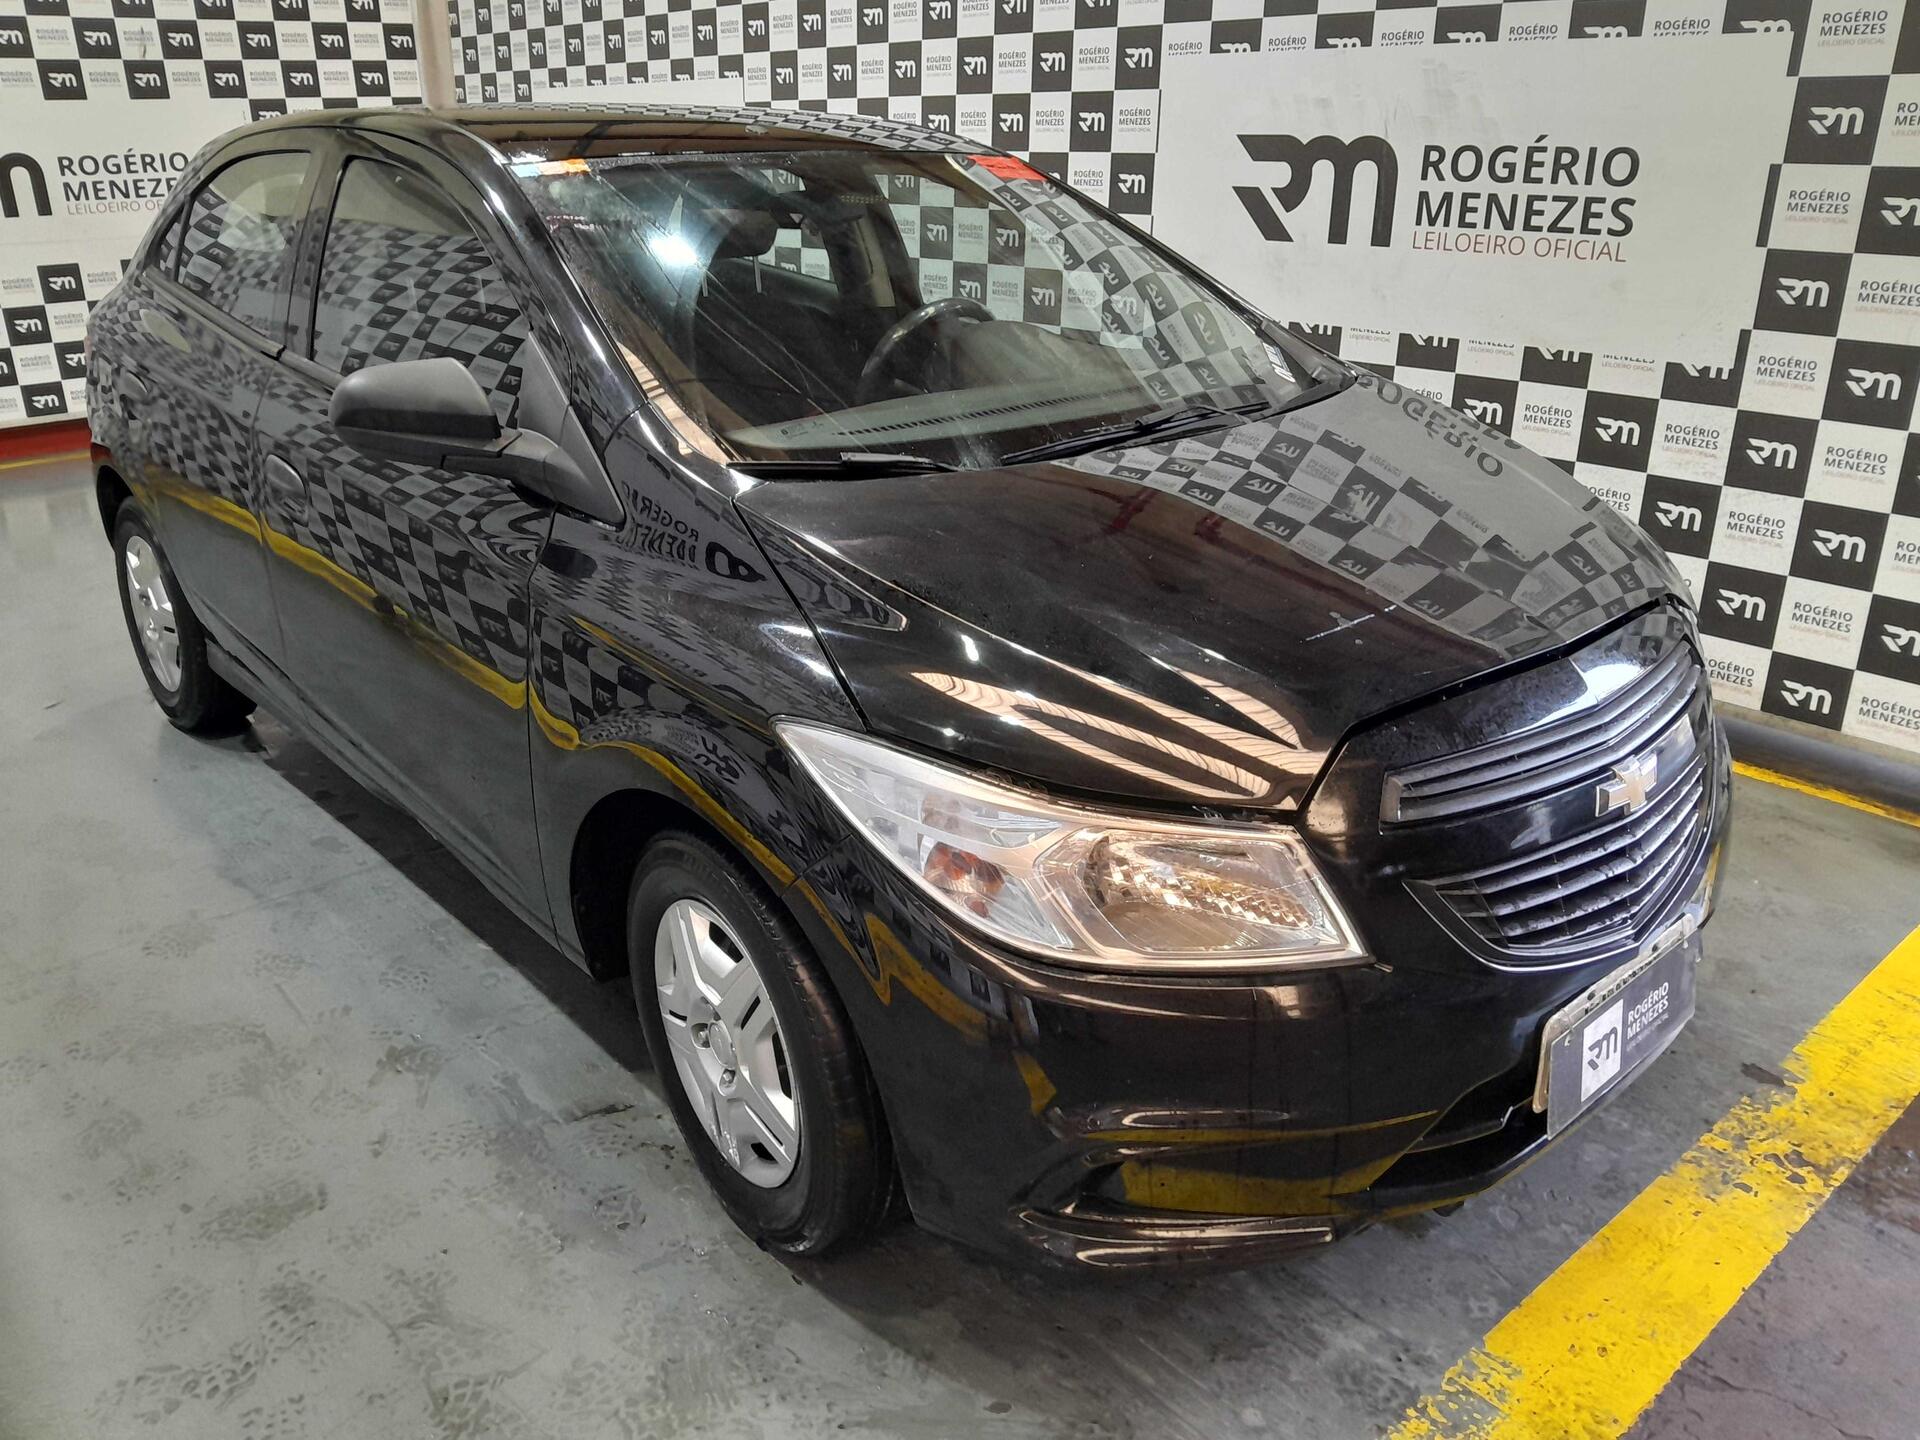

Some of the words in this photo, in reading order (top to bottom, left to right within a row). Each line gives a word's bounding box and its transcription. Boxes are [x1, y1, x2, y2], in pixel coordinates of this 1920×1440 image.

[829, 8, 851, 18] ROGÉRIO
[892, 2, 916, 12] ROGÉRIO
[772, 14, 792, 23] ROGÉRIO
[830, 16, 852, 25] MENEZES
[892, 10, 917, 19] MENEZES
[1822, 10, 1887, 24] ROGÉRIO
[772, 22, 792, 30] MENEZES
[1509, 24, 1558, 36] ROGÉRIO
[1654, 17, 1711, 31] ROGÉRIO
[1820, 24, 1886, 36] MENEZES
[1268, 36, 1307, 47] ROGÉRIO
[1381, 30, 1425, 41] ROGÉRIO
[1078, 45, 1109, 55] ROGÉRIO
[1168, 41, 1203, 51] ROGÉRIO
[926, 55, 951, 64] ROGÉRIO
[998, 50, 1026, 60] ROGÉRIO
[1078, 54, 1109, 64] MENEZES
[801, 62, 822, 70] ROGÉRIO
[861, 59, 883, 67] ROGÉRIO
[926, 63, 951, 71] MENEZES
[998, 59, 1026, 68] MENEZES
[861, 66, 883, 74] MENEZES
[960, 110, 986, 119] ROGÉRIO
[1035, 109, 1064, 118] ROGÉRIO
[1118, 107, 1150, 116] ROGÉRIO
[1035, 118, 1064, 126] MENEZES
[1118, 117, 1150, 125] MENEZES
[57, 148, 189, 177] ROGÉRIO
[1421, 134, 1640, 187] ROGÉRIO
[1073, 167, 1103, 176] ROGÉRIO
[1073, 176, 1103, 184] MENEZES
[1789, 189, 1851, 202] ROGÉRIO
[67, 200, 141, 216] LEILOEIRO
[1787, 201, 1850, 214] MENEZES
[1415, 191, 1637, 237] MENEZES
[1412, 231, 1525, 255] LEILOEIRO
[1534, 237, 1627, 262] OFICIAL
[1757, 356, 1817, 371] ROGÉRIO
[1756, 366, 1816, 382] MENEZES
[1526, 404, 1573, 418] ROGÉRIO
[1524, 413, 1573, 428] MENEZES
[1666, 424, 1720, 440] ROGÉRIO
[1664, 433, 1719, 450] MENEZES
[1825, 446, 1888, 464] ROGÉRIO
[1823, 457, 1886, 475] MENEZES
[1589, 487, 1631, 501] OGÉRIO
[1728, 511, 1785, 529] ROGÉRIO
[1727, 521, 1784, 539] MENEZES
[1793, 601, 1853, 622] ROGÉRIO
[1791, 611, 1852, 632] MENEZES
[1707, 658, 1755, 678] OGÉRIO
[1709, 671, 1753, 688] ENEZES
[1628, 982, 1669, 1025] ROGÉRIO
[1627, 996, 1669, 1039] MENEZES
